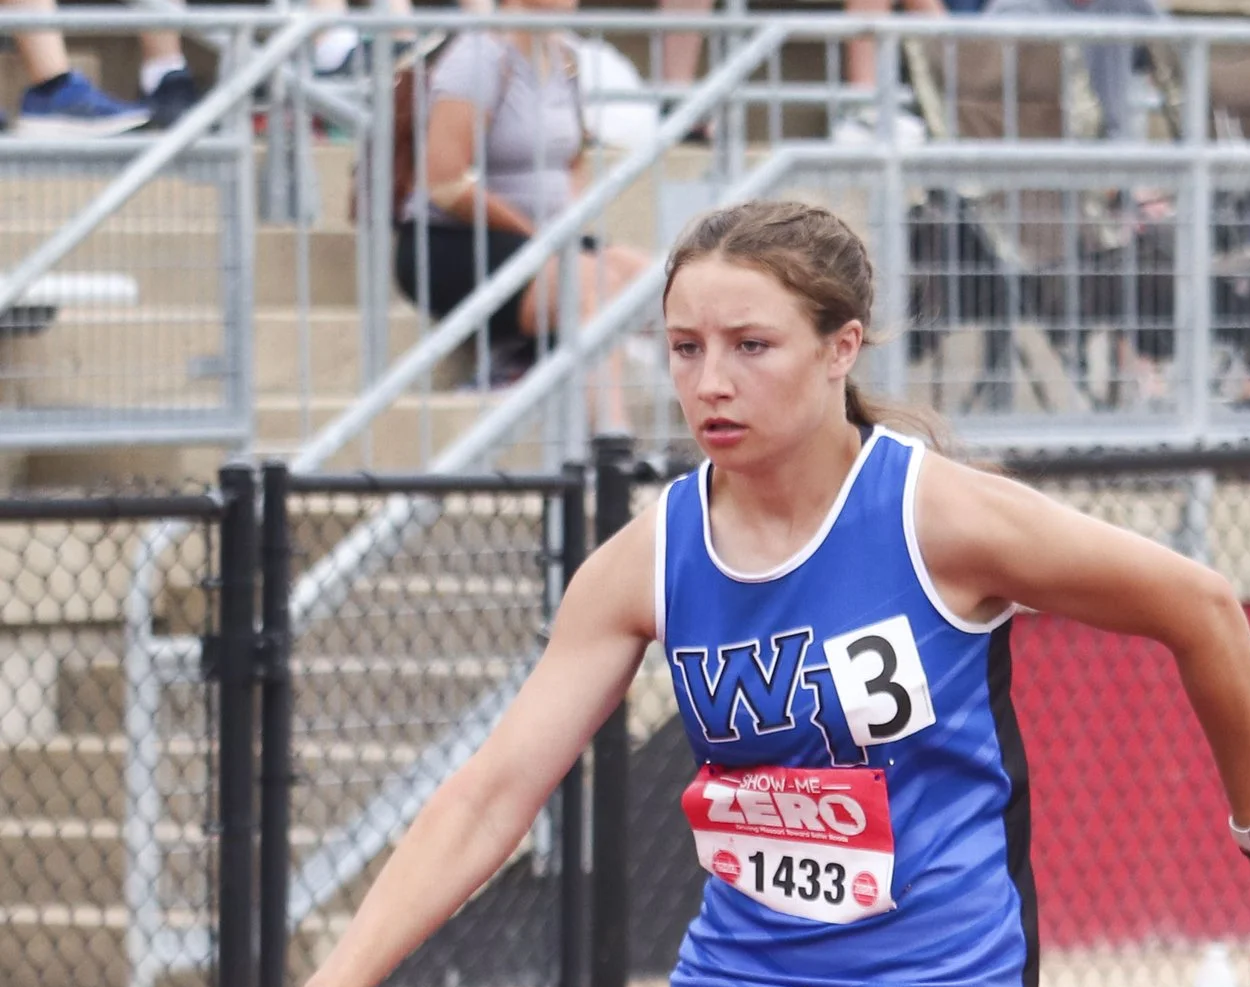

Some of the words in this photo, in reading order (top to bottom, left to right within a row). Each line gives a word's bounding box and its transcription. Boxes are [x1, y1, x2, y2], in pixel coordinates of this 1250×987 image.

[847, 634, 912, 739] 3
[703, 782, 867, 836] ZERO
[748, 850, 847, 905] 1433
